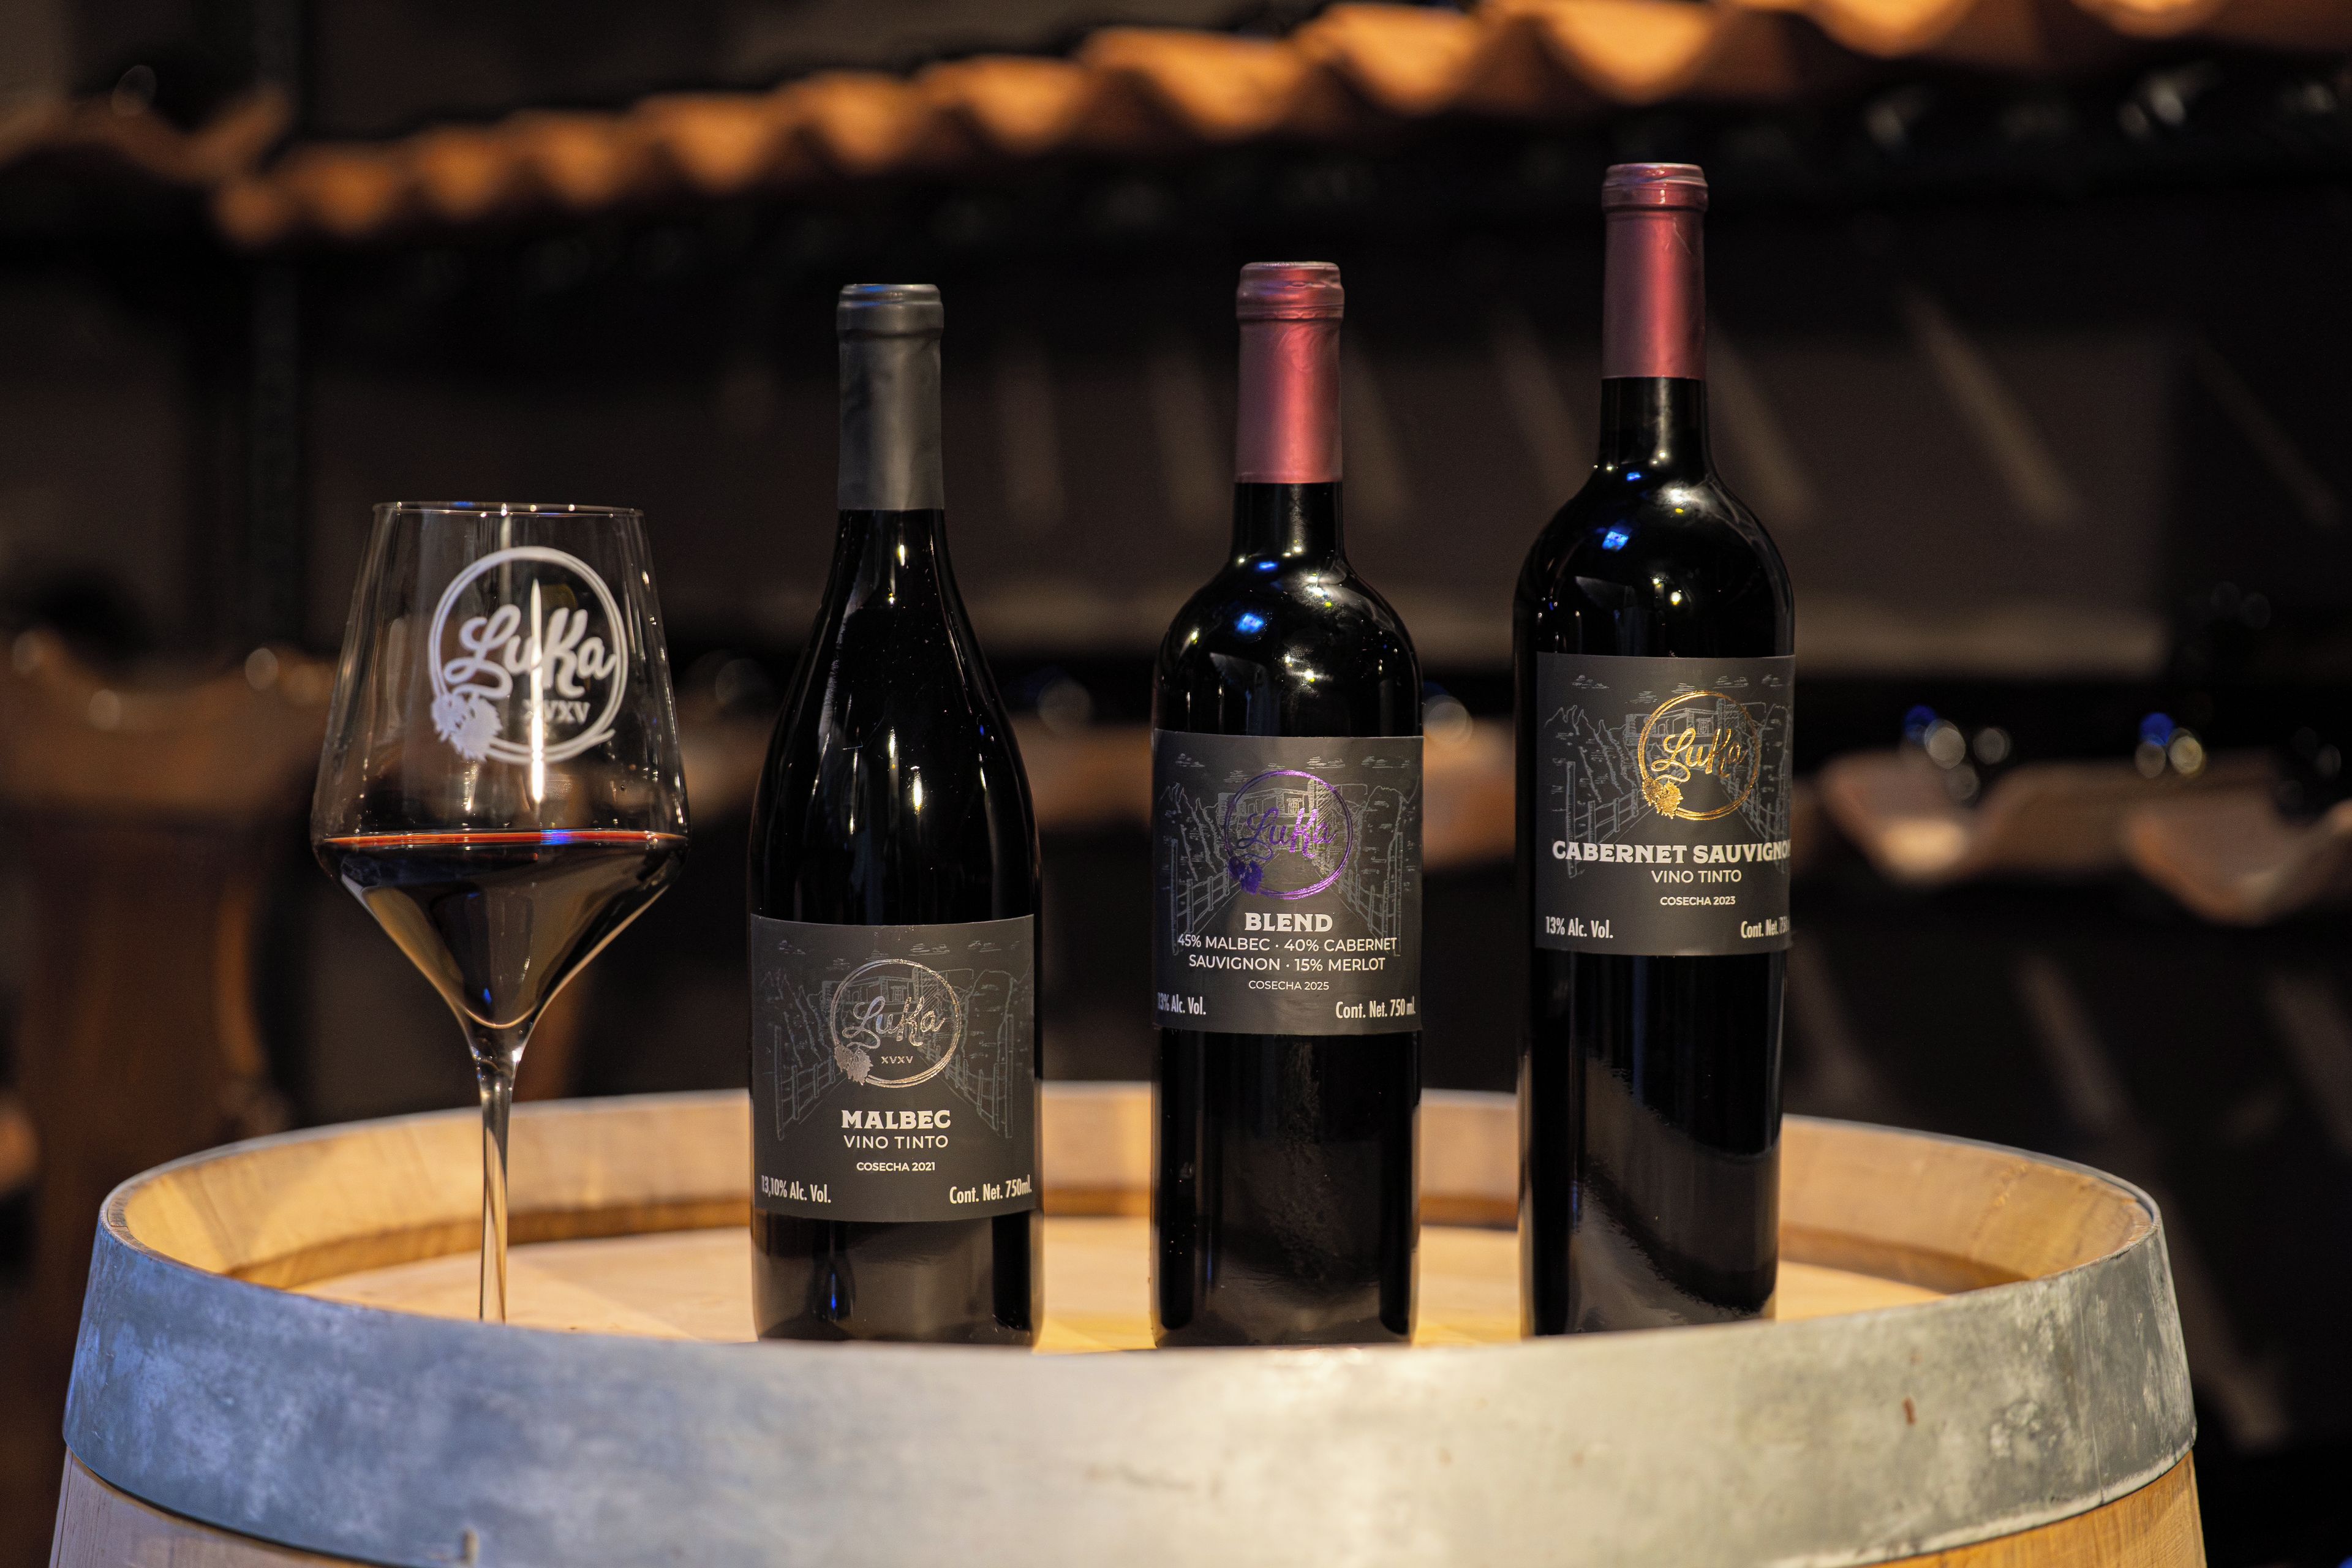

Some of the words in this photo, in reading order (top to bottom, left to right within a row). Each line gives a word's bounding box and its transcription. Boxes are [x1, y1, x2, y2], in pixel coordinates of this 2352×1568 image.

[1552, 840, 1688, 864] CABERNET
[1651, 870, 1694, 883] VINO
[1697, 869, 1742, 883] TINTO
[1659, 896, 1712, 906] COSECHA
[1713, 895, 1736, 906] 2023
[1244, 912, 1333, 932] BLEND
[1545, 916, 1566, 935] 13%
[1567, 918, 1588, 937] Alc.
[1590, 919, 1613, 939] Vol.
[1740, 921, 1764, 938] Cont.
[1765, 919, 1779, 937] Net.
[1177, 934, 1202, 948] 45%
[1205, 935, 1270, 951] MALBEC
[1283, 938, 1321, 952] 40%
[1322, 937, 1398, 952] CABERNET
[1189, 954, 1281, 971] SAUVIGNON
[1294, 958, 1324, 972] 15%
[1328, 957, 1386, 971] MERLOT
[1248, 980, 1302, 991] COSECHA
[1303, 981, 1330, 990] 2025
[1171, 993, 1185, 1014] Alc.
[1188, 996, 1207, 1016] Vol.
[1336, 1001, 1366, 1019] Cont.
[1369, 1000, 1388, 1018] Net.
[1390, 998, 1406, 1016] 750
[881, 1055, 913, 1064] XVXV
[841, 1109, 951, 1129] MALBEC
[843, 1135, 889, 1149] VINO
[894, 1135, 949, 1149] TINTO
[856, 1161, 910, 1172] COSECHA
[911, 1161, 935, 1172] 2021
[761, 1175, 788, 1198] 13,10%
[789, 1180, 807, 1200] Alc.
[810, 1183, 832, 1204] Vol.
[949, 1186, 979, 1204] Cont.
[982, 1183, 1003, 1201] Net.
[1005, 1174, 1032, 1198] 750ml.
